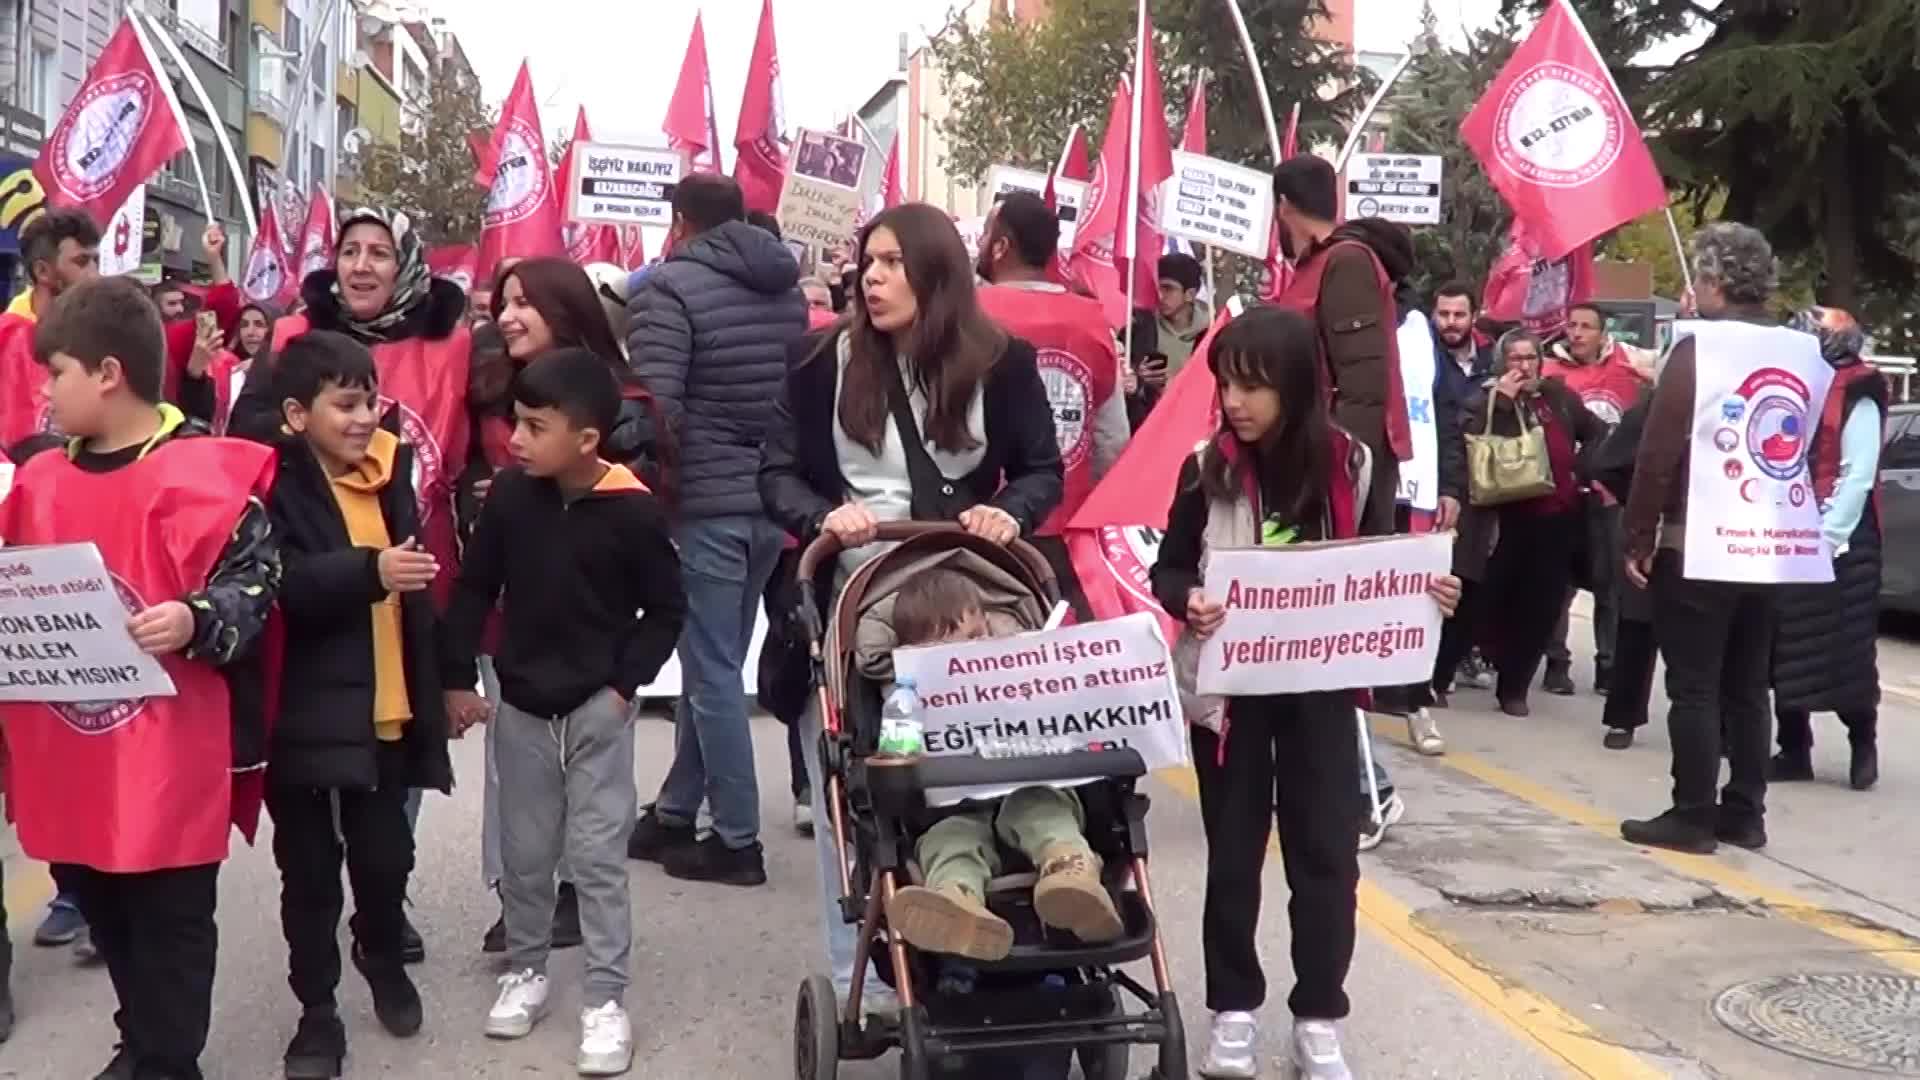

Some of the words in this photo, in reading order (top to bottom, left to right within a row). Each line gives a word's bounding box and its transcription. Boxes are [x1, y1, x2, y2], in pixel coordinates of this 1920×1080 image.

[1225, 577, 1336, 610] Annemin
[1344, 568, 1432, 603] hakkını
[34, 611, 102, 632] BANA
[0, 641, 79, 661] KALEM
[948, 643, 1048, 677] Annemi
[1054, 638, 1122, 663] işten
[1221, 621, 1425, 672] yedirmeyeceğim
[975, 676, 1077, 702] kreşten
[1083, 660, 1168, 687] attınız
[924, 716, 1029, 752] EĞİTİM
[1038, 698, 1173, 737] HAKKIMI
